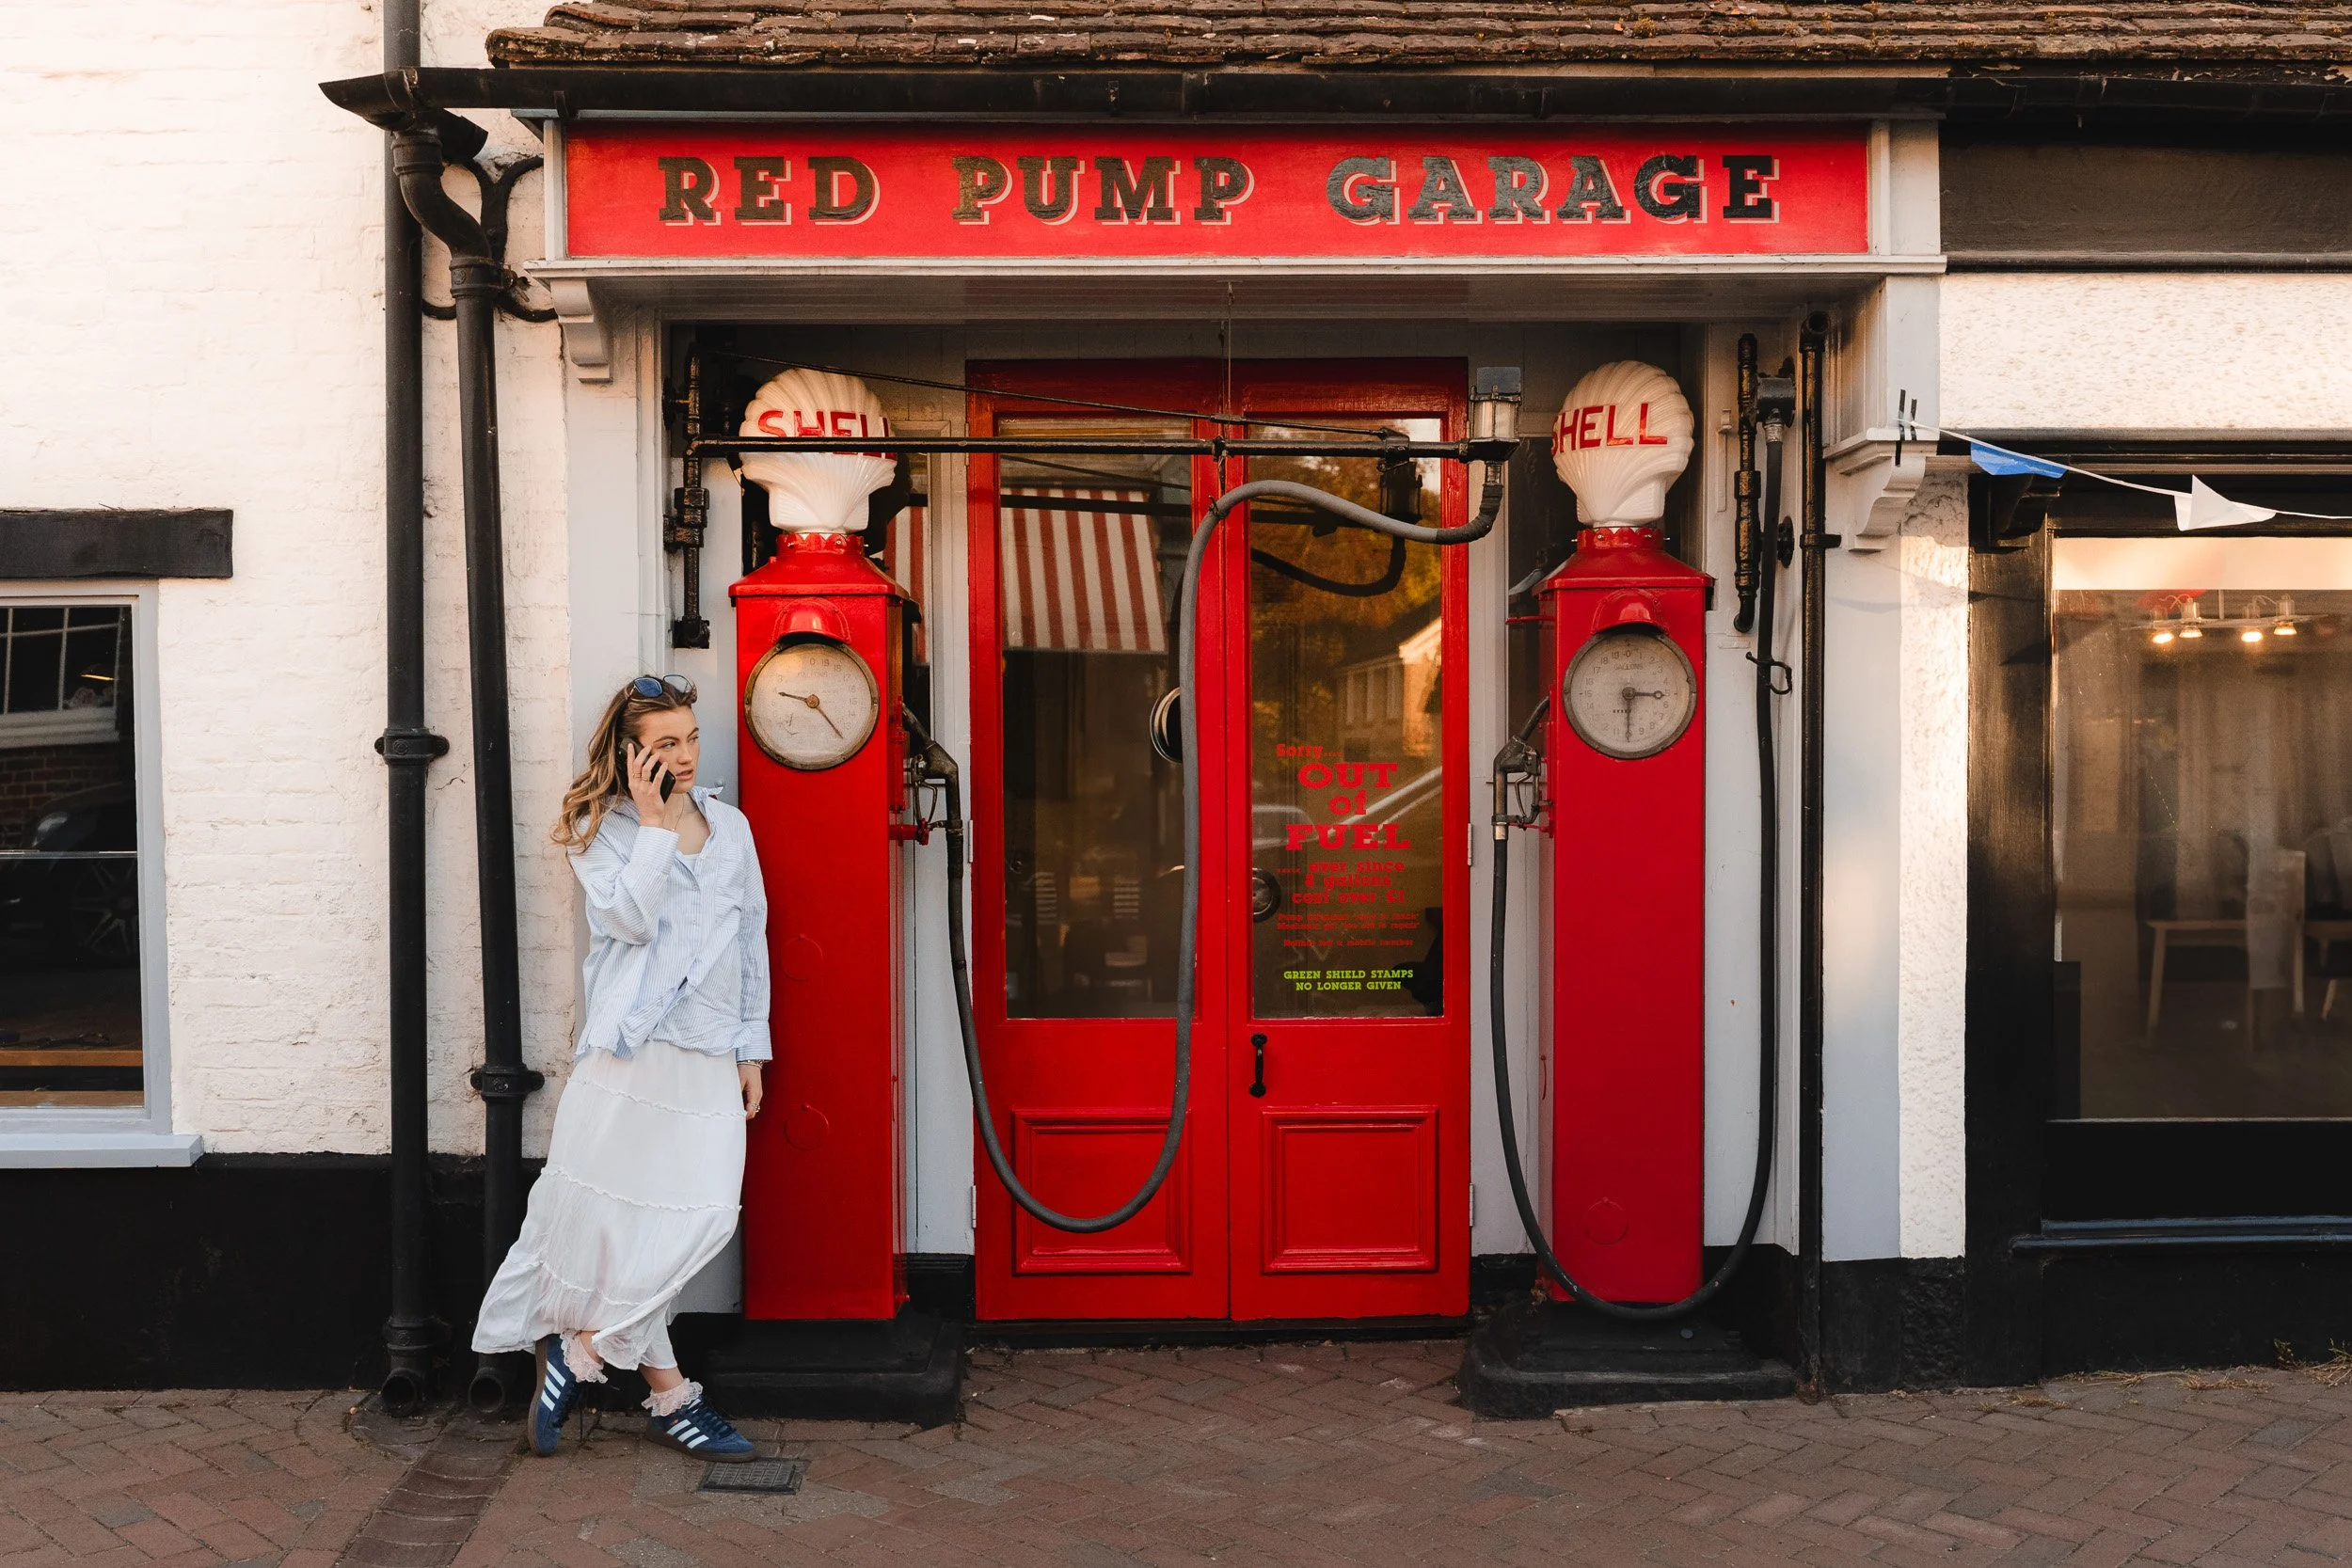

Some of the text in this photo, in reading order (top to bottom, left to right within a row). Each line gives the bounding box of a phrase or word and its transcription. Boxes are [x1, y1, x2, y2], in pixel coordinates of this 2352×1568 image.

[659, 155, 1780, 226] RED PUMP GARAGE
[821, 658, 830, 667] 19
[834, 664, 841, 673] 18
[1593, 666, 1601, 674] 17
[1298, 762, 1399, 789] OUT
[1329, 789, 1367, 816] of
[1285, 824, 1411, 850] FUEL
[1309, 862, 1347, 873] ever
[1357, 859, 1405, 873] since
[1324, 874, 1391, 891] gallons
[1292, 890, 1405, 903] cost over £1
[1283, 970, 1413, 979] GREEN SHIELD STAMPS
[1295, 981, 1401, 990] NO LONGER GIVEN
